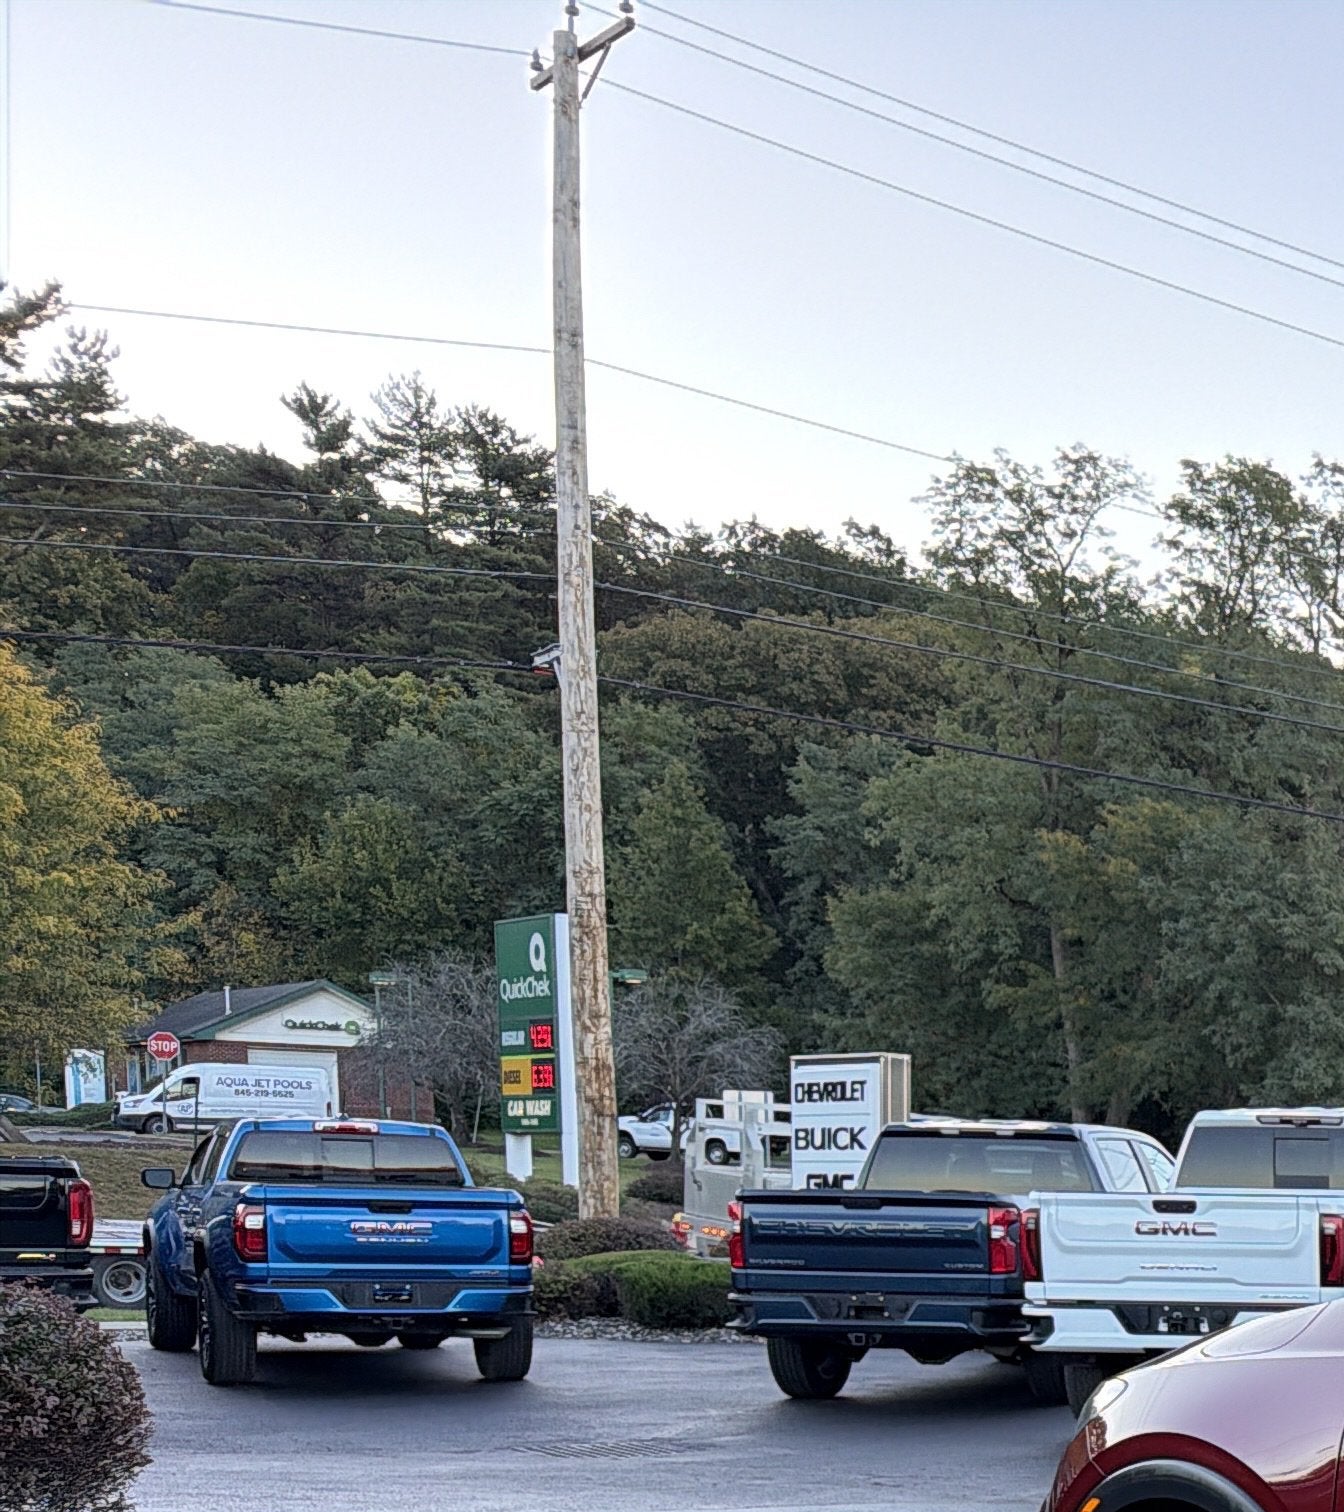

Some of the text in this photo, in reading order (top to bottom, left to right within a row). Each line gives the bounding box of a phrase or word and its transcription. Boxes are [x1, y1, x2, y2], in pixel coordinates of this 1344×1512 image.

[529, 932, 547, 972] Q
[500, 974, 551, 1003] QuickChek
[150, 1040, 178, 1052] STOP
[216, 1077, 313, 1090] AQUA JET POOLS
[795, 1081, 867, 1102] CHEVROLET
[507, 1100, 551, 1116] CAR WASH
[795, 1126, 867, 1150] BUICK
[807, 1174, 854, 1190] GMC
[350, 1221, 433, 1235] GMC
[757, 1220, 969, 1238] CHEVROLET
[1135, 1221, 1217, 1236] GMC
